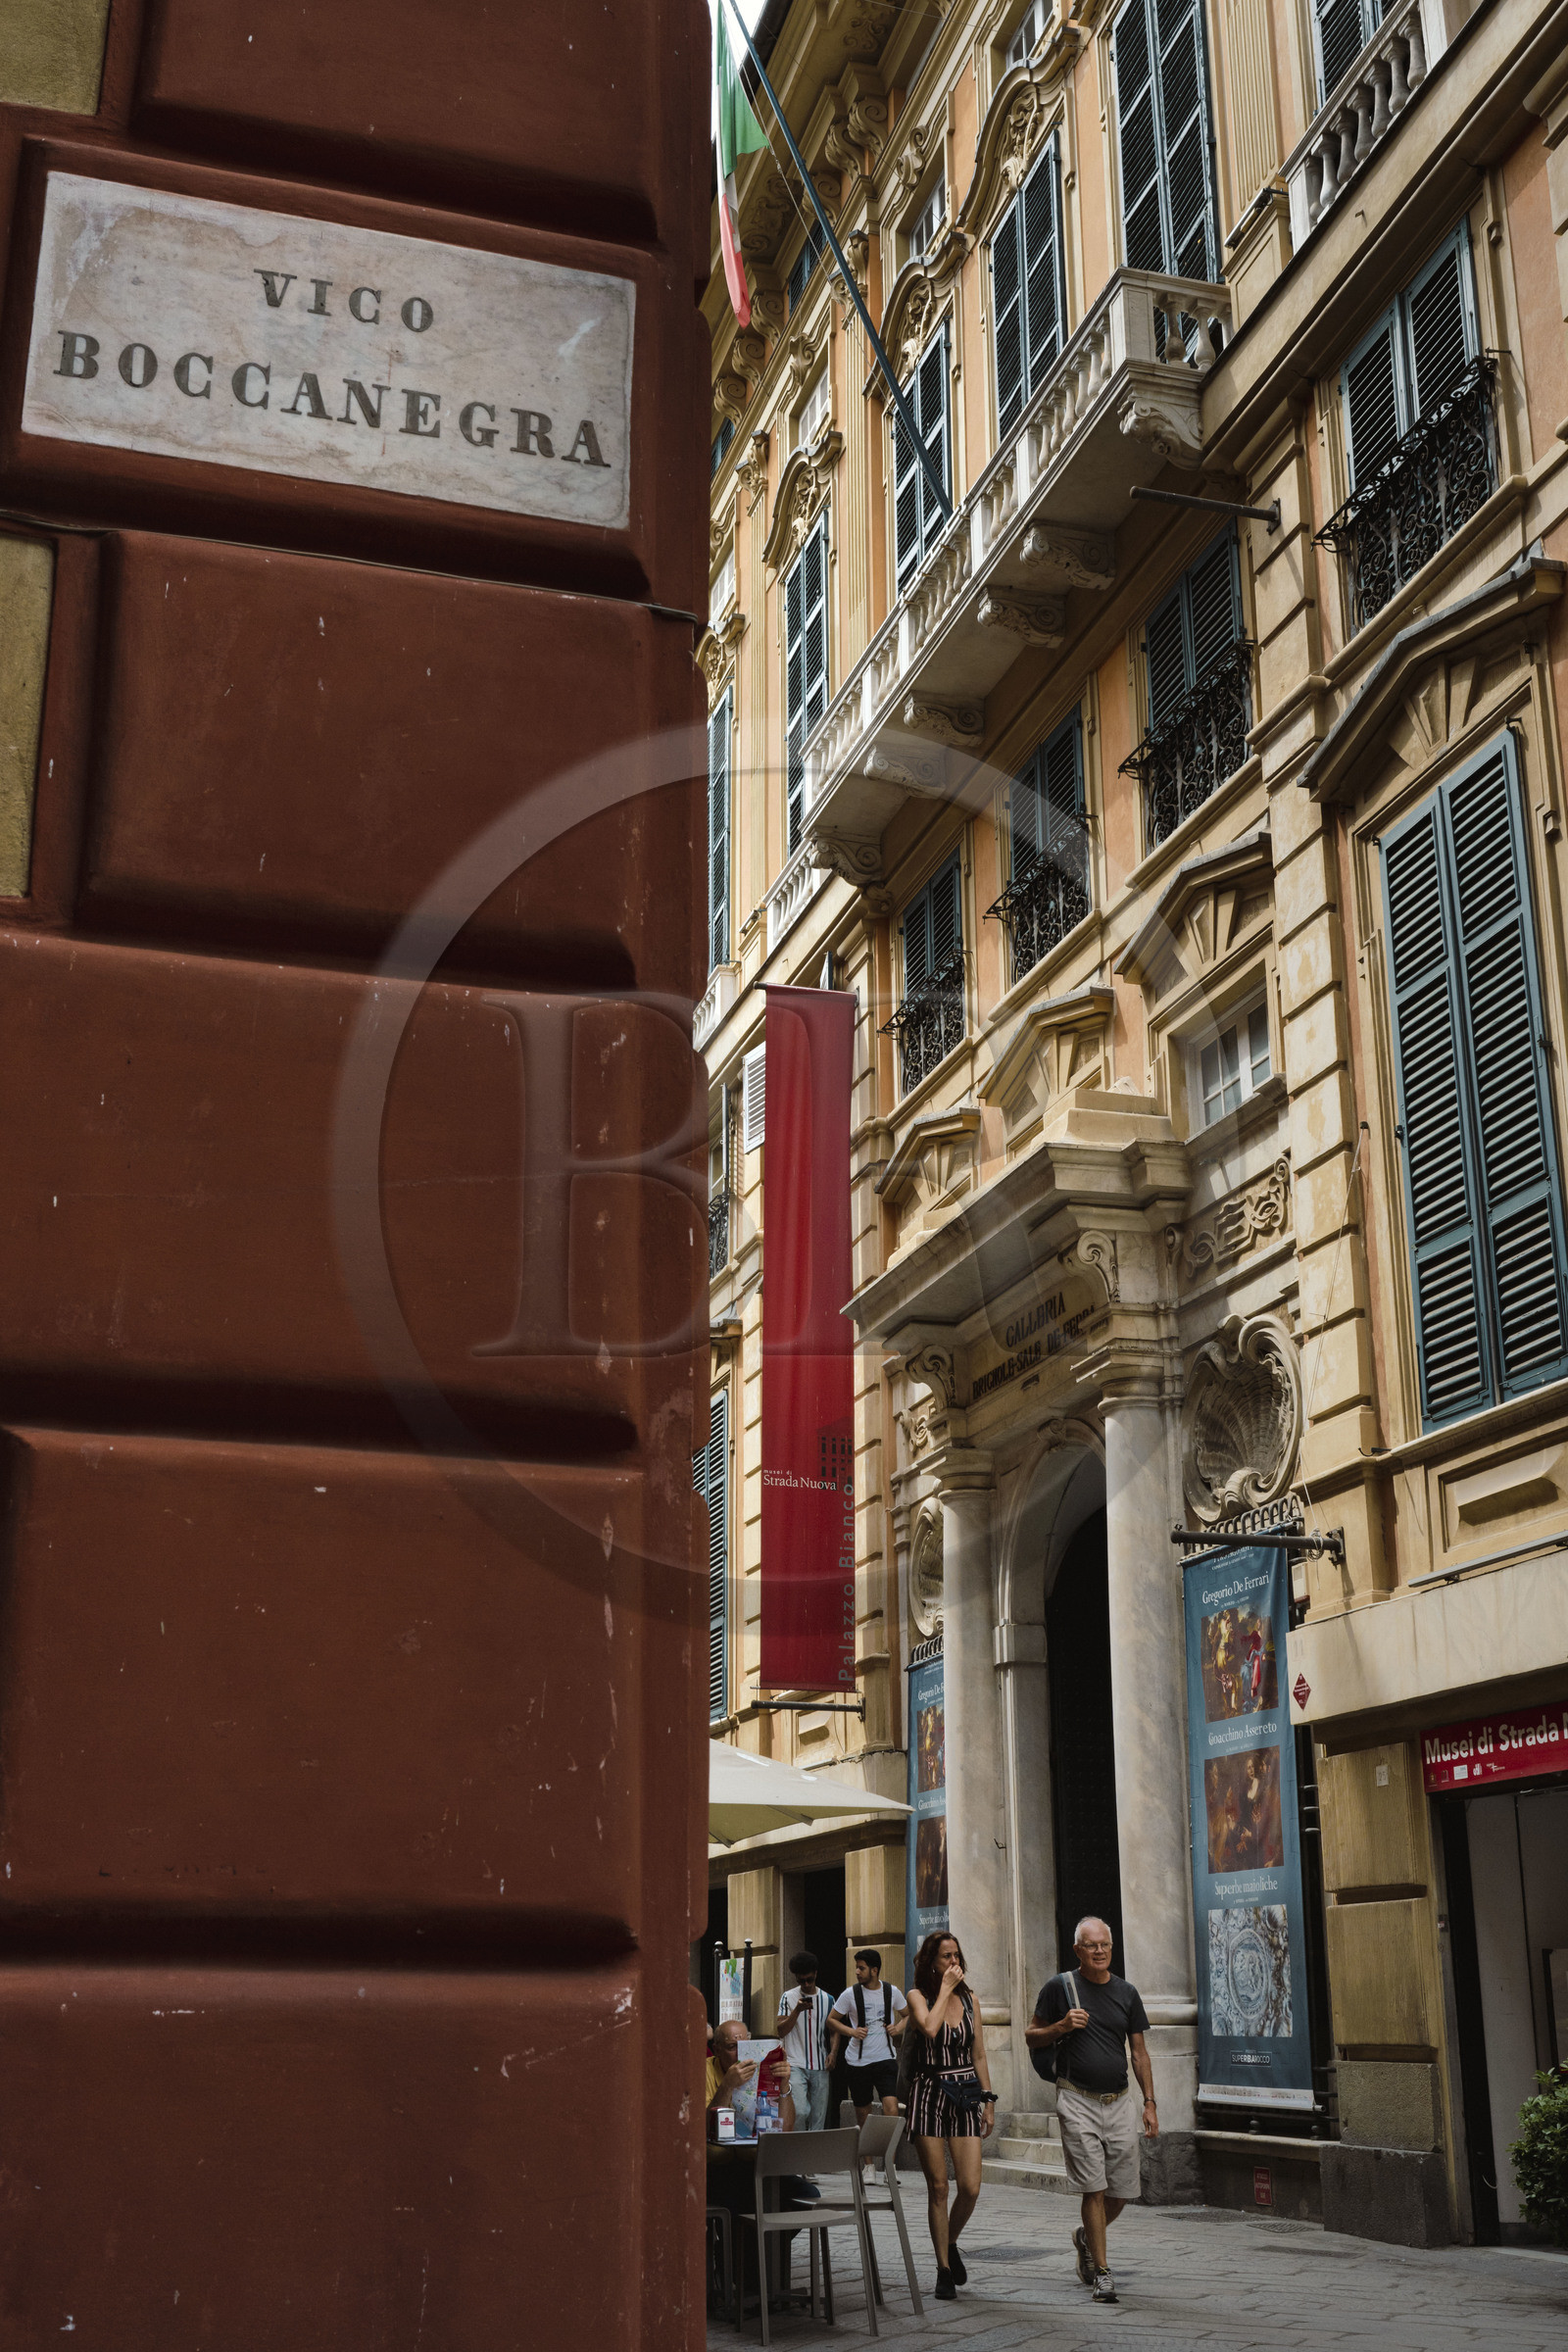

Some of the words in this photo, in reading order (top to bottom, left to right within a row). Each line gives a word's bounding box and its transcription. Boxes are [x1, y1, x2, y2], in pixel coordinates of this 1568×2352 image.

[253, 269, 434, 333] VICO
[52, 329, 612, 468] BOCCANEGRA
[763, 1474, 799, 1488] Strada
[800, 1477, 837, 1491] Nuova
[839, 1484, 855, 1568] Bianco
[1201, 1585, 1234, 1606] Gregorio
[1233, 1580, 1244, 1594] De
[1245, 1570, 1270, 1591] Ferrari
[838, 1584, 855, 1681] Palazzo
[1244, 1722, 1278, 1739] Assereto
[1424, 1731, 1474, 1765] Musei
[1477, 1726, 1494, 1755] di
[1498, 1714, 1559, 1751] Strada
[1243, 1875, 1279, 1893] maioliche
